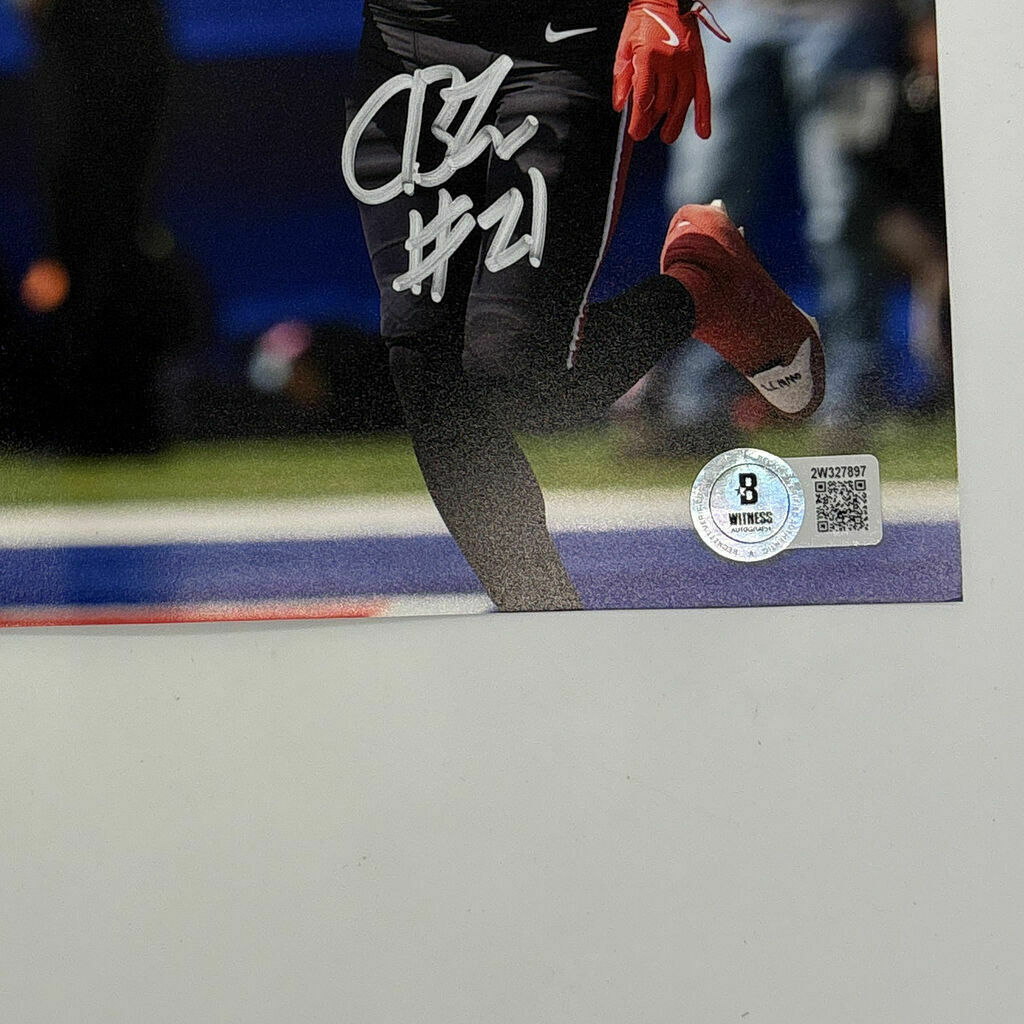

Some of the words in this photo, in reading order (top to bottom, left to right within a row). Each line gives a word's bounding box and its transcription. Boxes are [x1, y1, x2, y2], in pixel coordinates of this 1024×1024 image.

[392, 166, 548, 303] #21
[810, 465, 866, 480] 2W327897
[728, 511, 773, 526] WITNESS
